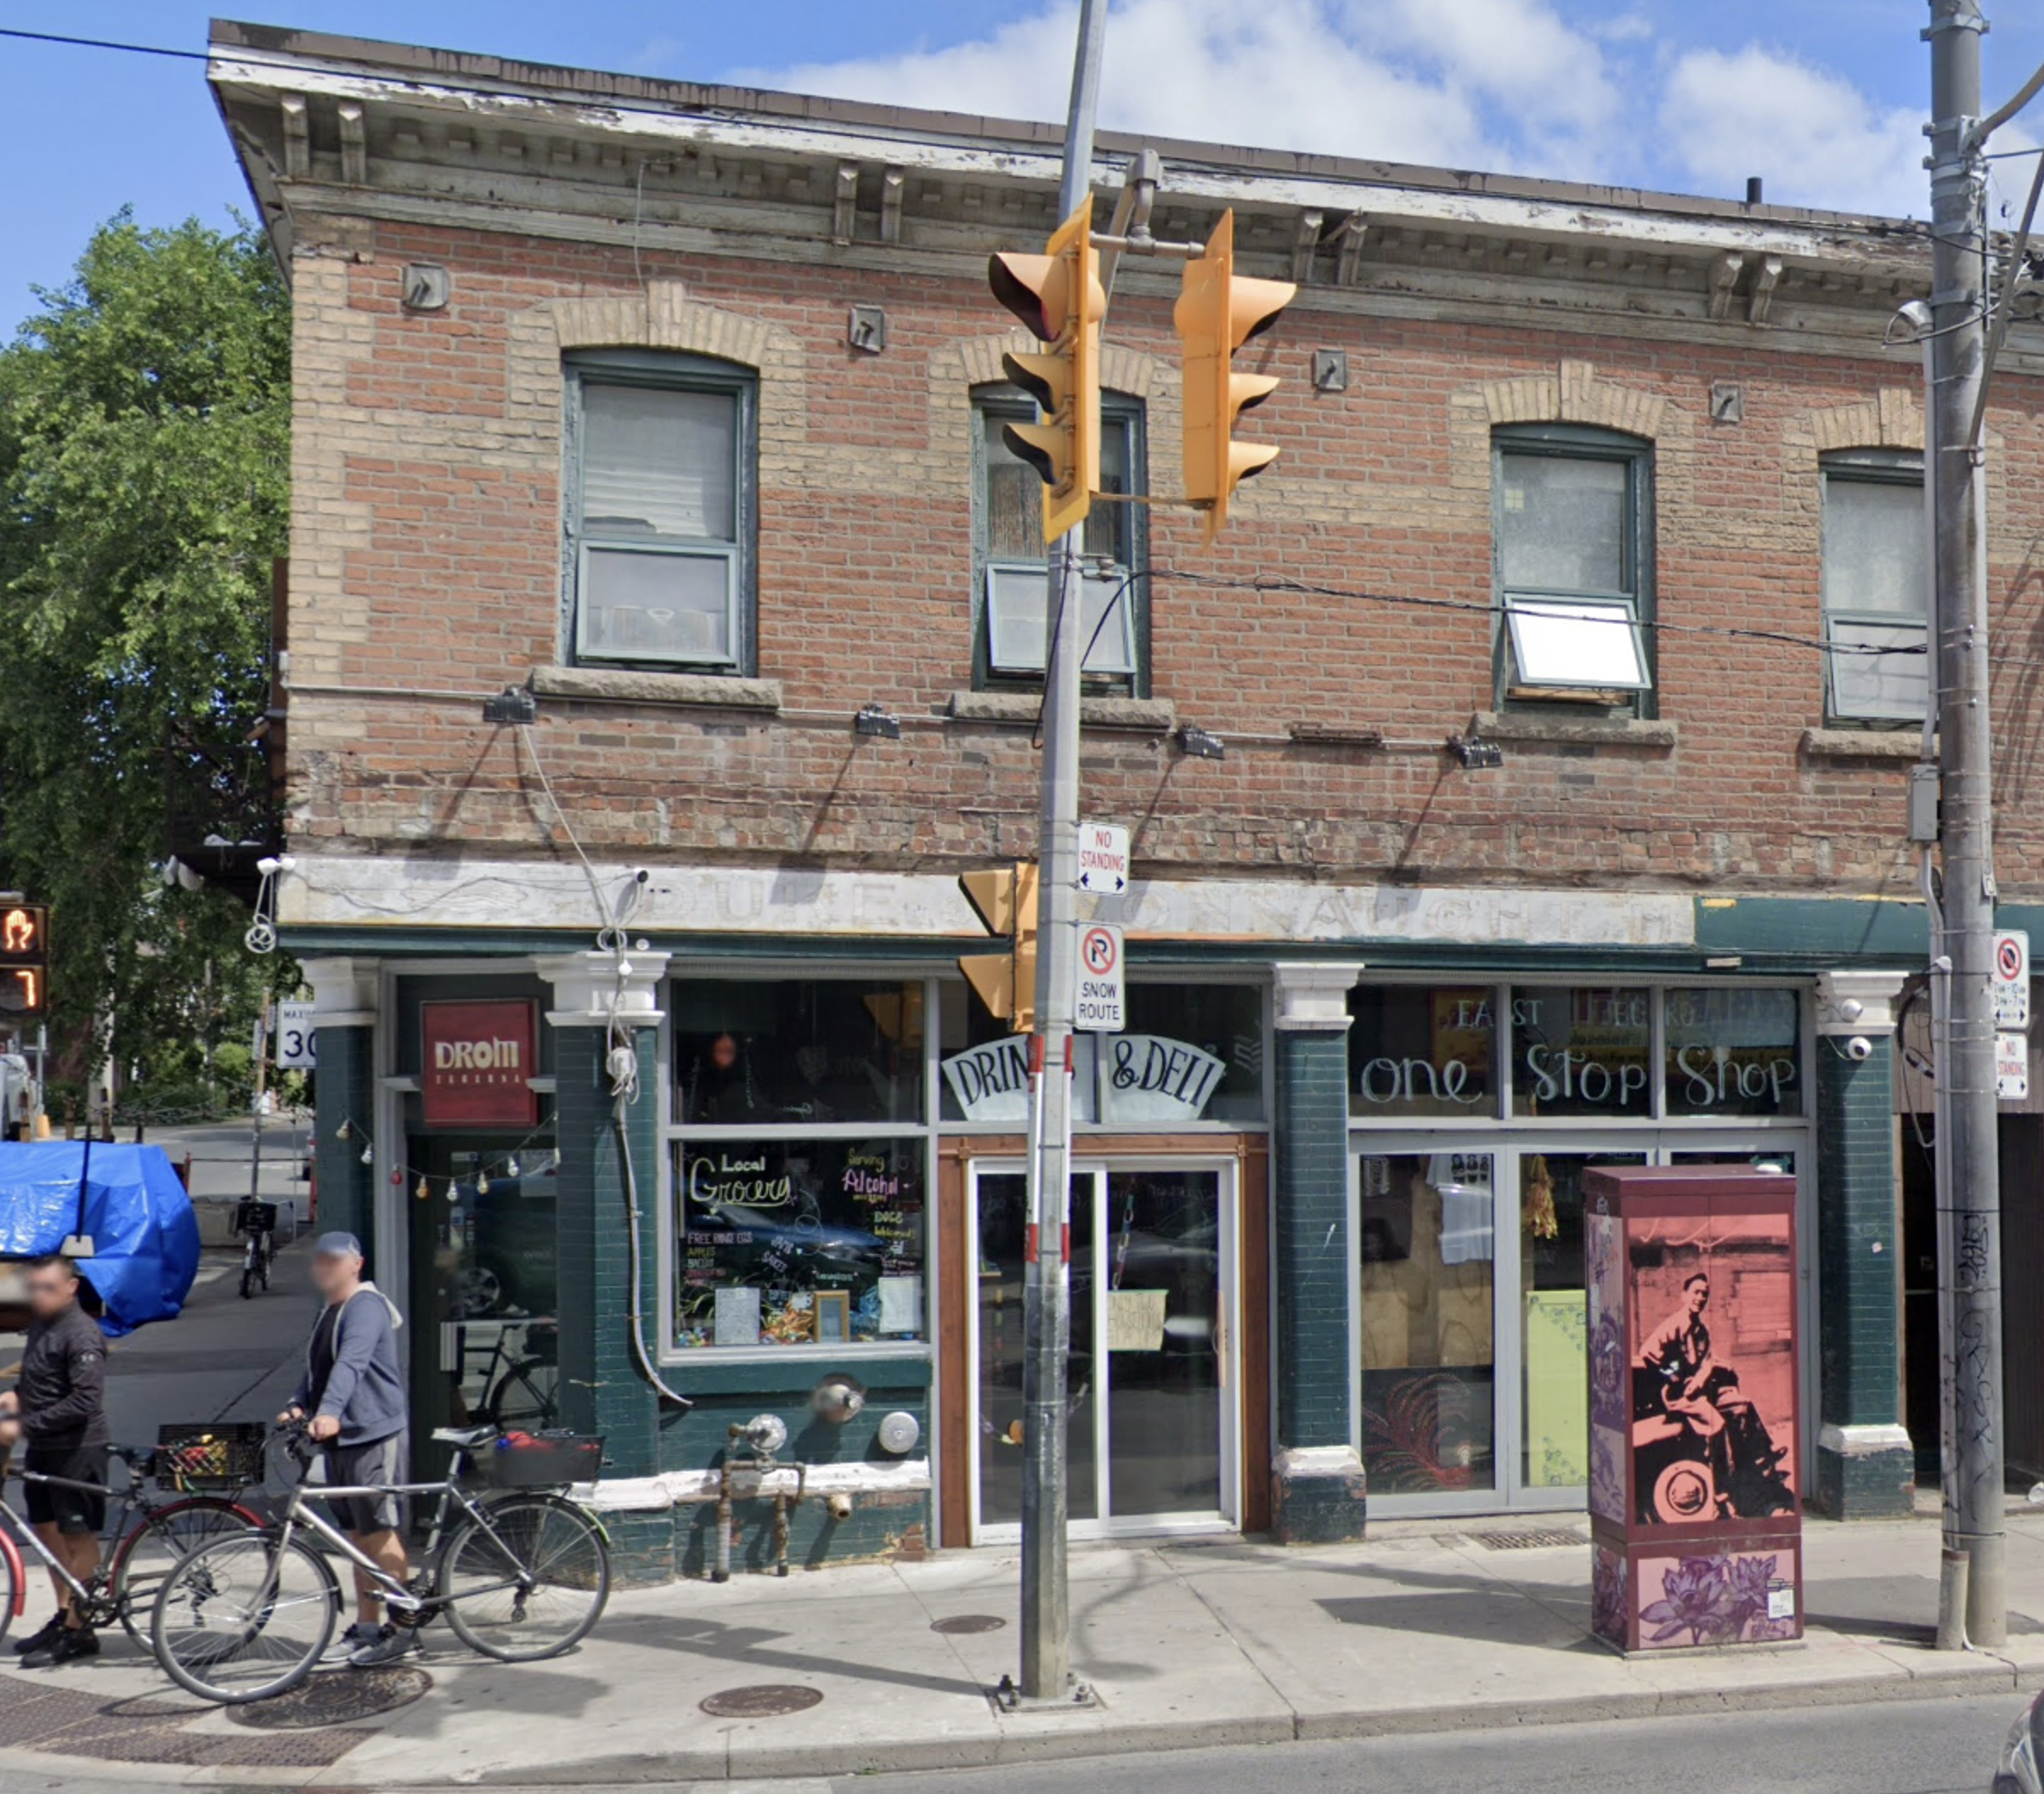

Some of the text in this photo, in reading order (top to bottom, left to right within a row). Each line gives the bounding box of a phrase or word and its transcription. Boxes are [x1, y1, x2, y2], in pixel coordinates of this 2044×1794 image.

[1096, 831, 1112, 849] NO
[1081, 850, 1126, 872] STANDING
[1081, 981, 1117, 998] SNOW
[1079, 1003, 1121, 1020] ROUTE
[2006, 1041, 2017, 1057] NO
[1112, 1039, 1139, 1090] &
[1138, 1039, 1216, 1107] DELI
[1361, 1058, 1483, 1104] one
[1527, 1044, 1647, 1105] Stop
[1676, 1043, 1796, 1106] Shop
[1997, 1060, 2025, 1077] STANDING
[721, 1153, 766, 1172] Local
[847, 1148, 885, 1173] Serving
[690, 1157, 791, 1208] Grocery
[841, 1168, 898, 1196] Alcohol
[686, 1233, 711, 1244] FREE
